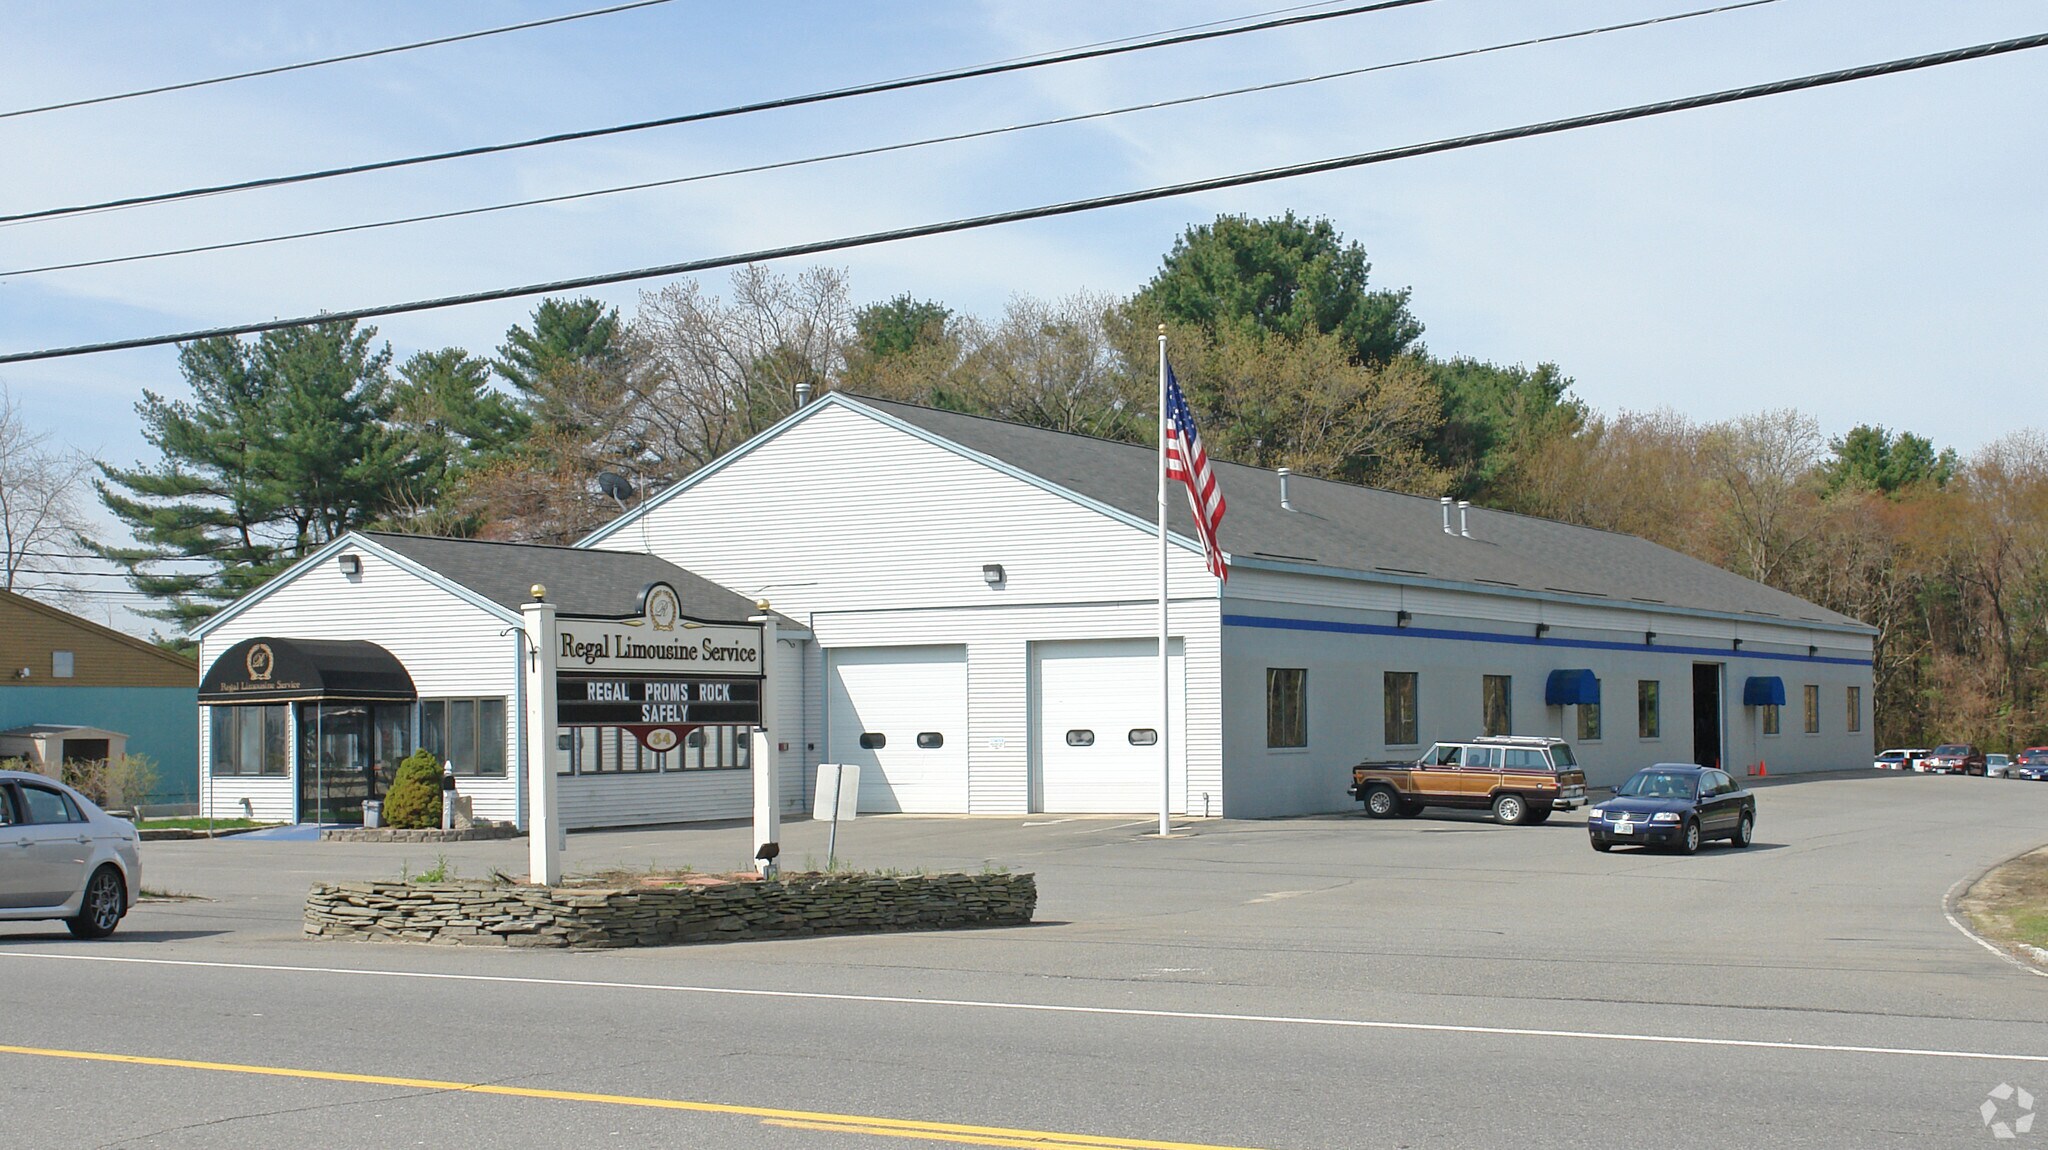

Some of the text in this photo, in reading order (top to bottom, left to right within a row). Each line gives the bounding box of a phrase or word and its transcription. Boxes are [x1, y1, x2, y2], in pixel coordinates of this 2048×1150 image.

[561, 633, 757, 664] Regal Limousine Service
[220, 682, 239, 692] Regal
[276, 680, 301, 689] Service
[587, 682, 731, 701] REGAL PROMS ROCK
[641, 704, 688, 723] SAFELY
[652, 732, 671, 745] 34
